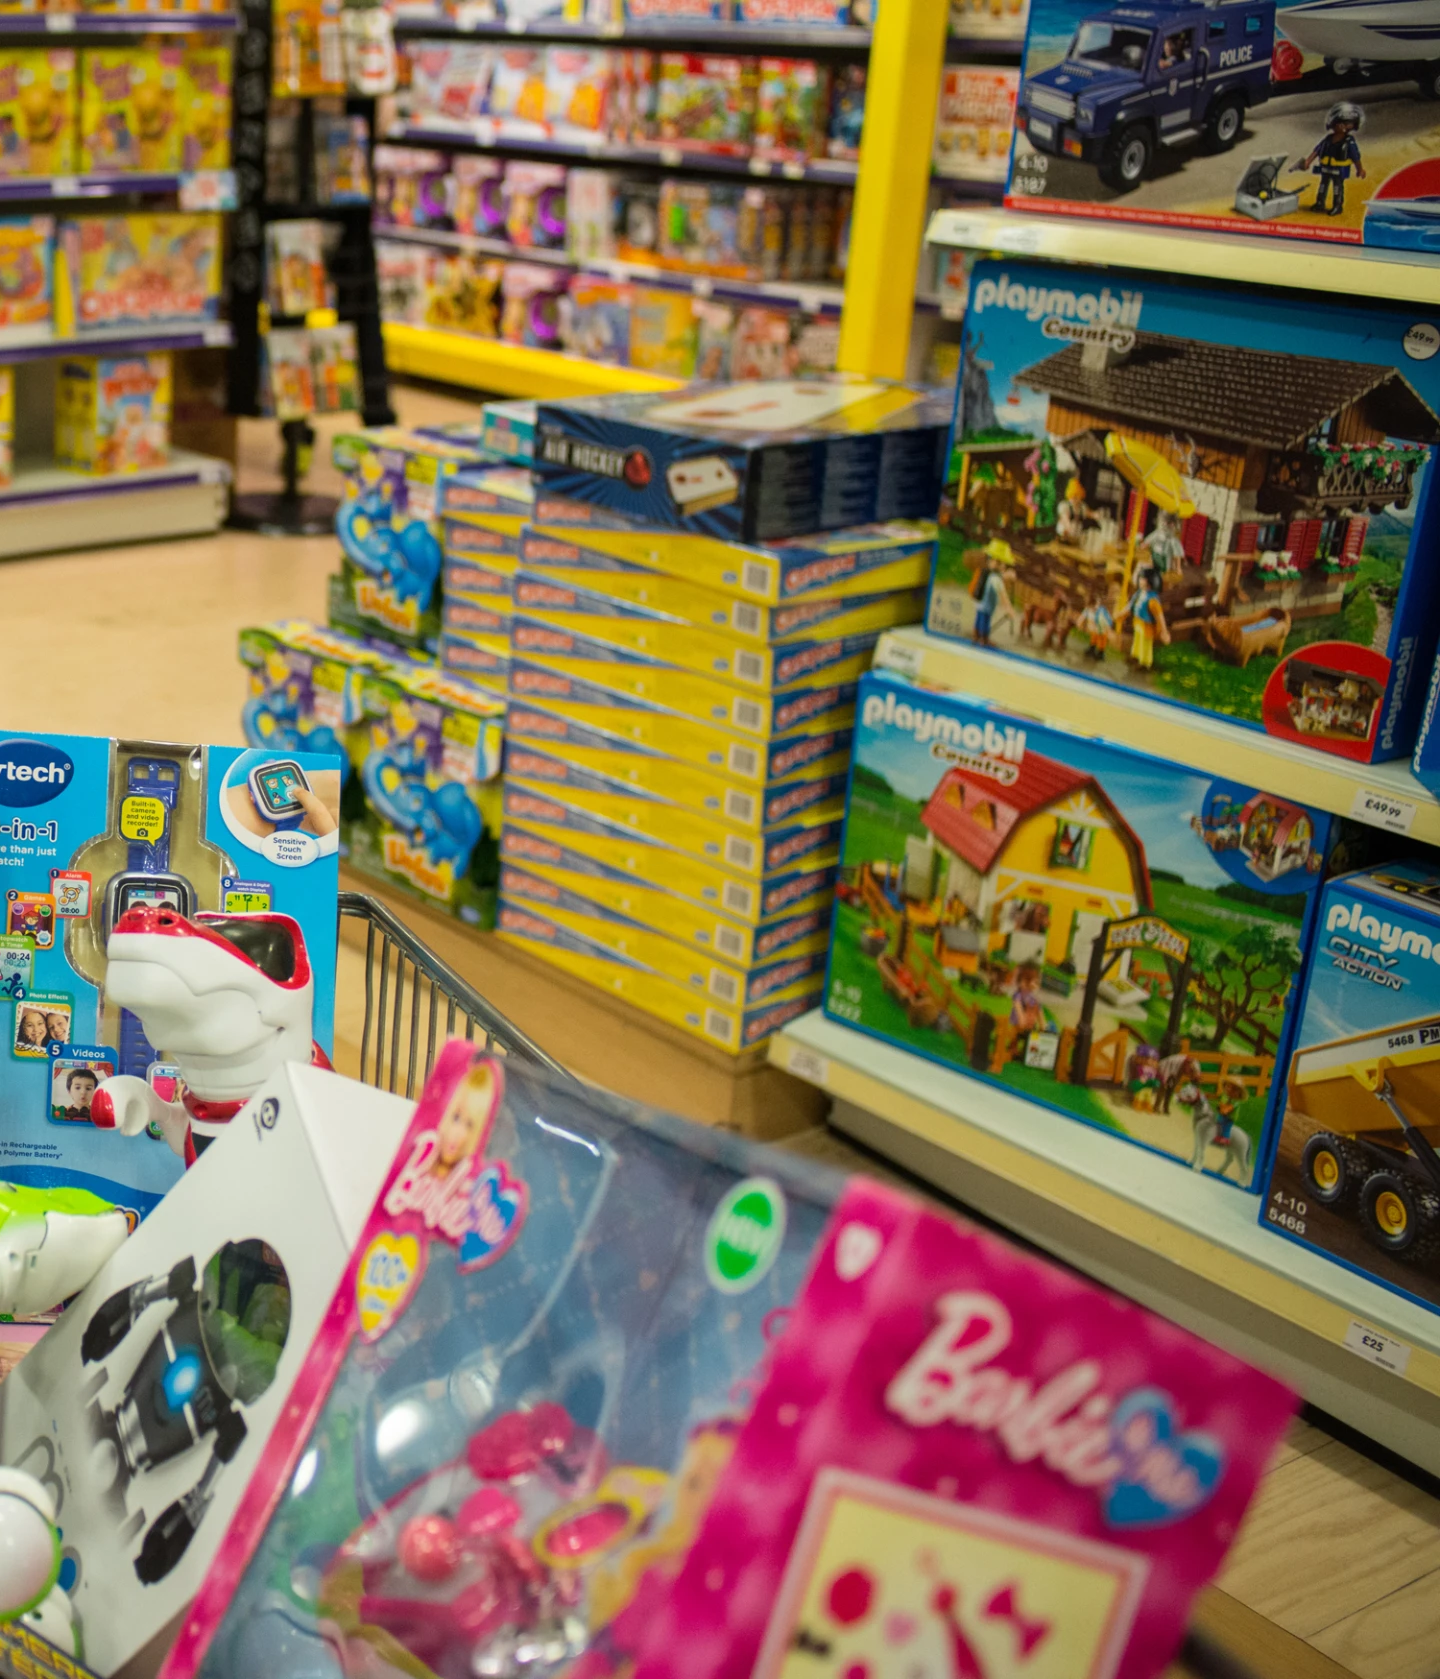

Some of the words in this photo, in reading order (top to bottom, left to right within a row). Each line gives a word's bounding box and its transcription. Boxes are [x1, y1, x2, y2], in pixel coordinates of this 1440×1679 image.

[1220, 45, 1253, 69] POLICE
[1014, 176, 1047, 195] 5187
[974, 274, 1143, 330] playmobil
[1043, 317, 1136, 352] Country
[543, 438, 567, 463] AIR
[572, 444, 624, 479] HOCKEY
[1381, 636, 1414, 750] playmobil
[862, 691, 1027, 765] playmobil
[931, 741, 1018, 784] Country
[131, 800, 156, 808] Built-in
[1365, 798, 1402, 818] £49.99
[127, 820, 158, 828] recorder!
[273, 837, 307, 847] Sensitive
[10, 845, 34, 855] than
[35, 846, 57, 857] just
[278, 845, 302, 854] Touch
[276, 852, 303, 861] Screen
[53, 869, 58, 878] 1
[65, 872, 83, 880] Alarm
[224, 879, 231, 888] 8
[10, 892, 17, 900] 2
[23, 894, 46, 902] Games
[242, 893, 253, 902] 12
[60, 906, 80, 914] 08:00
[6, 951, 30, 961] 00:24
[1328, 935, 1399, 973] CITY
[1332, 958, 1404, 992] ACTION
[15, 988, 24, 999] 4
[29, 992, 47, 1000] Photo
[48, 993, 69, 1001] Effects
[1388, 1033, 1415, 1049] 5468
[52, 1044, 60, 1056] 5
[72, 1049, 106, 1060] Videos
[9, 1141, 58, 1151] Rechargeable
[3, 1149, 33, 1159] Polymer
[1273, 1190, 1308, 1216] 4-10
[1268, 1206, 1307, 1236] 5468
[1362, 1335, 1385, 1352] £25
[885, 1291, 1118, 1487] Barbie
